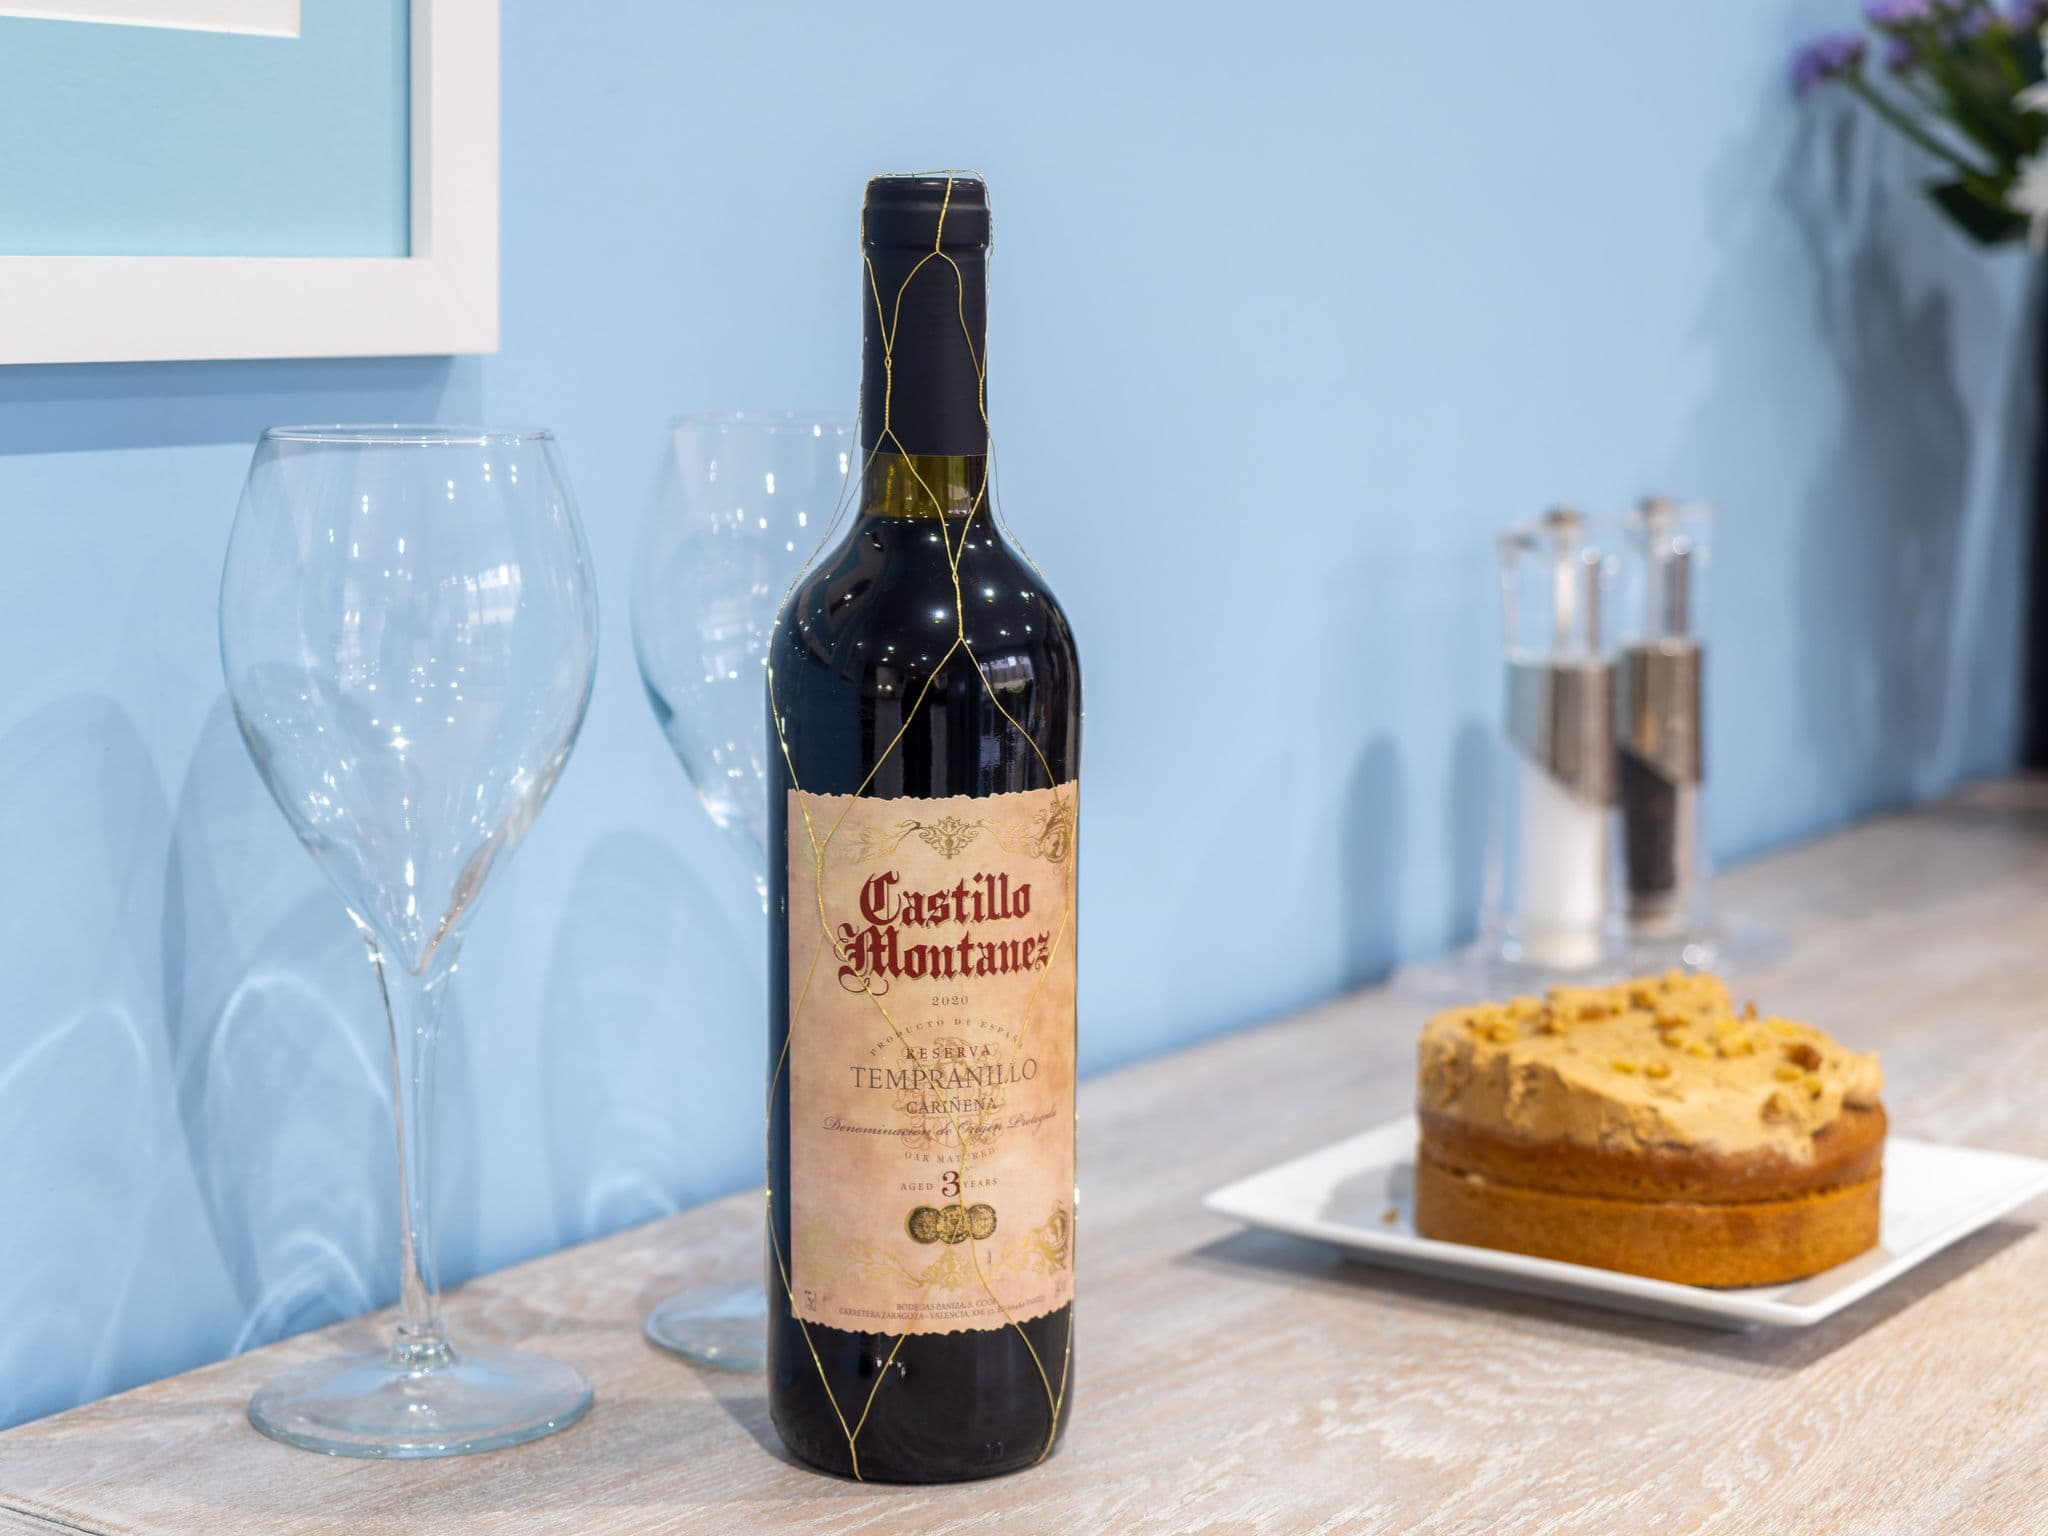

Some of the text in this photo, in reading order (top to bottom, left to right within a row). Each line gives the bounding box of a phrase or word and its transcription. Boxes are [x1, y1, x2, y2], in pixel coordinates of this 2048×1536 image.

[860, 871, 1031, 927] Castillo
[834, 923, 1050, 995] Montanez
[931, 995, 969, 1006] 2020
[906, 1045, 992, 1060] RESERVA
[850, 1058, 1038, 1090] TEMPRANILLO
[936, 1120, 954, 1136] de
[904, 1147, 996, 1163] OAK MATRED
[900, 1170, 998, 1198] AGED 3 YEARS
